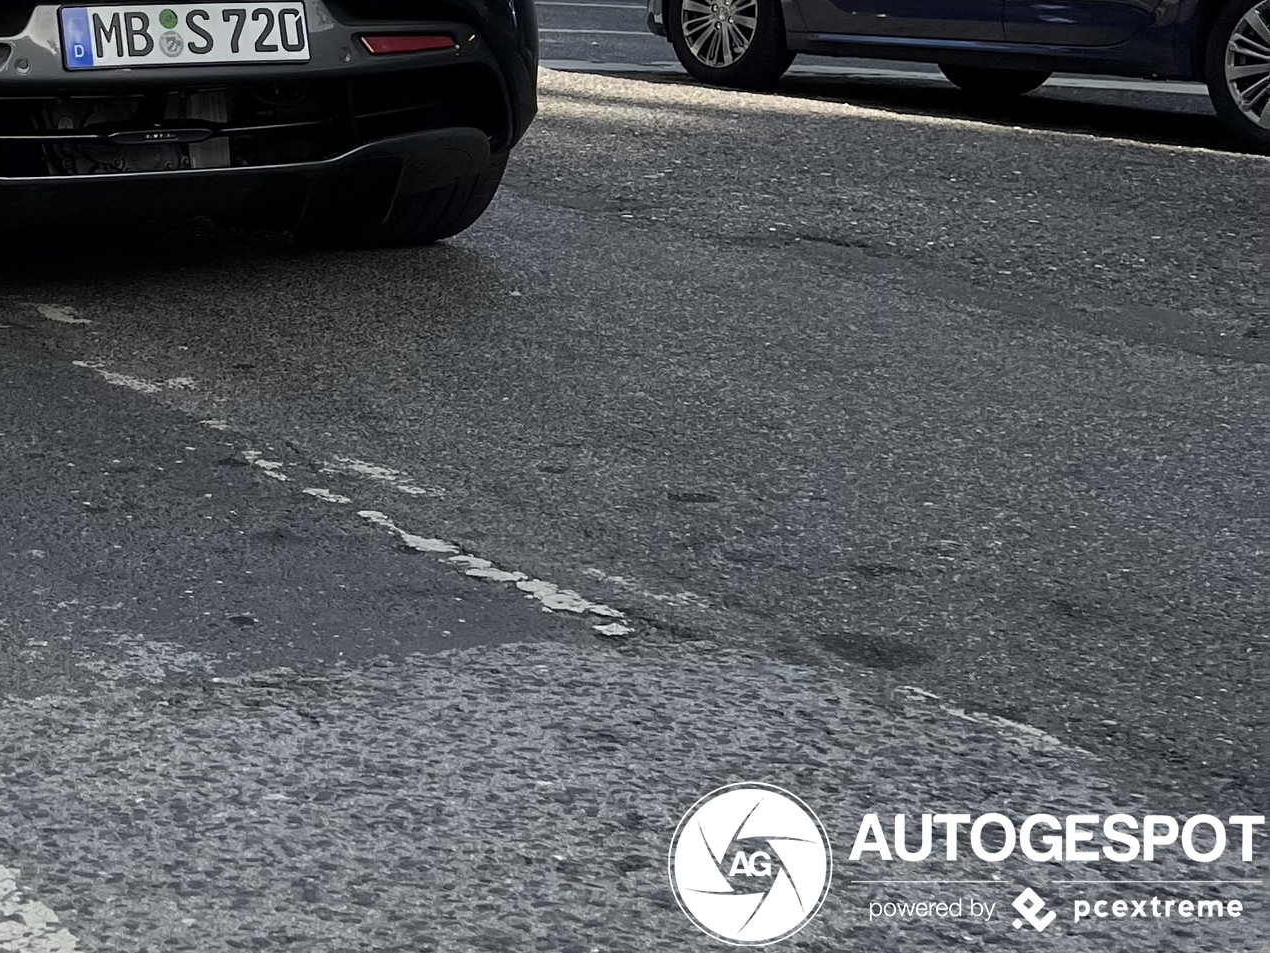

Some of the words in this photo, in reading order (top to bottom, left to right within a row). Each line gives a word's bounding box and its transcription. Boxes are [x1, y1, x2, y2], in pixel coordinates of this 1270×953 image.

[92, 11, 155, 58] MB
[186, 9, 214, 55] S
[222, 7, 306, 54] 720
[74, 45, 85, 58] D
